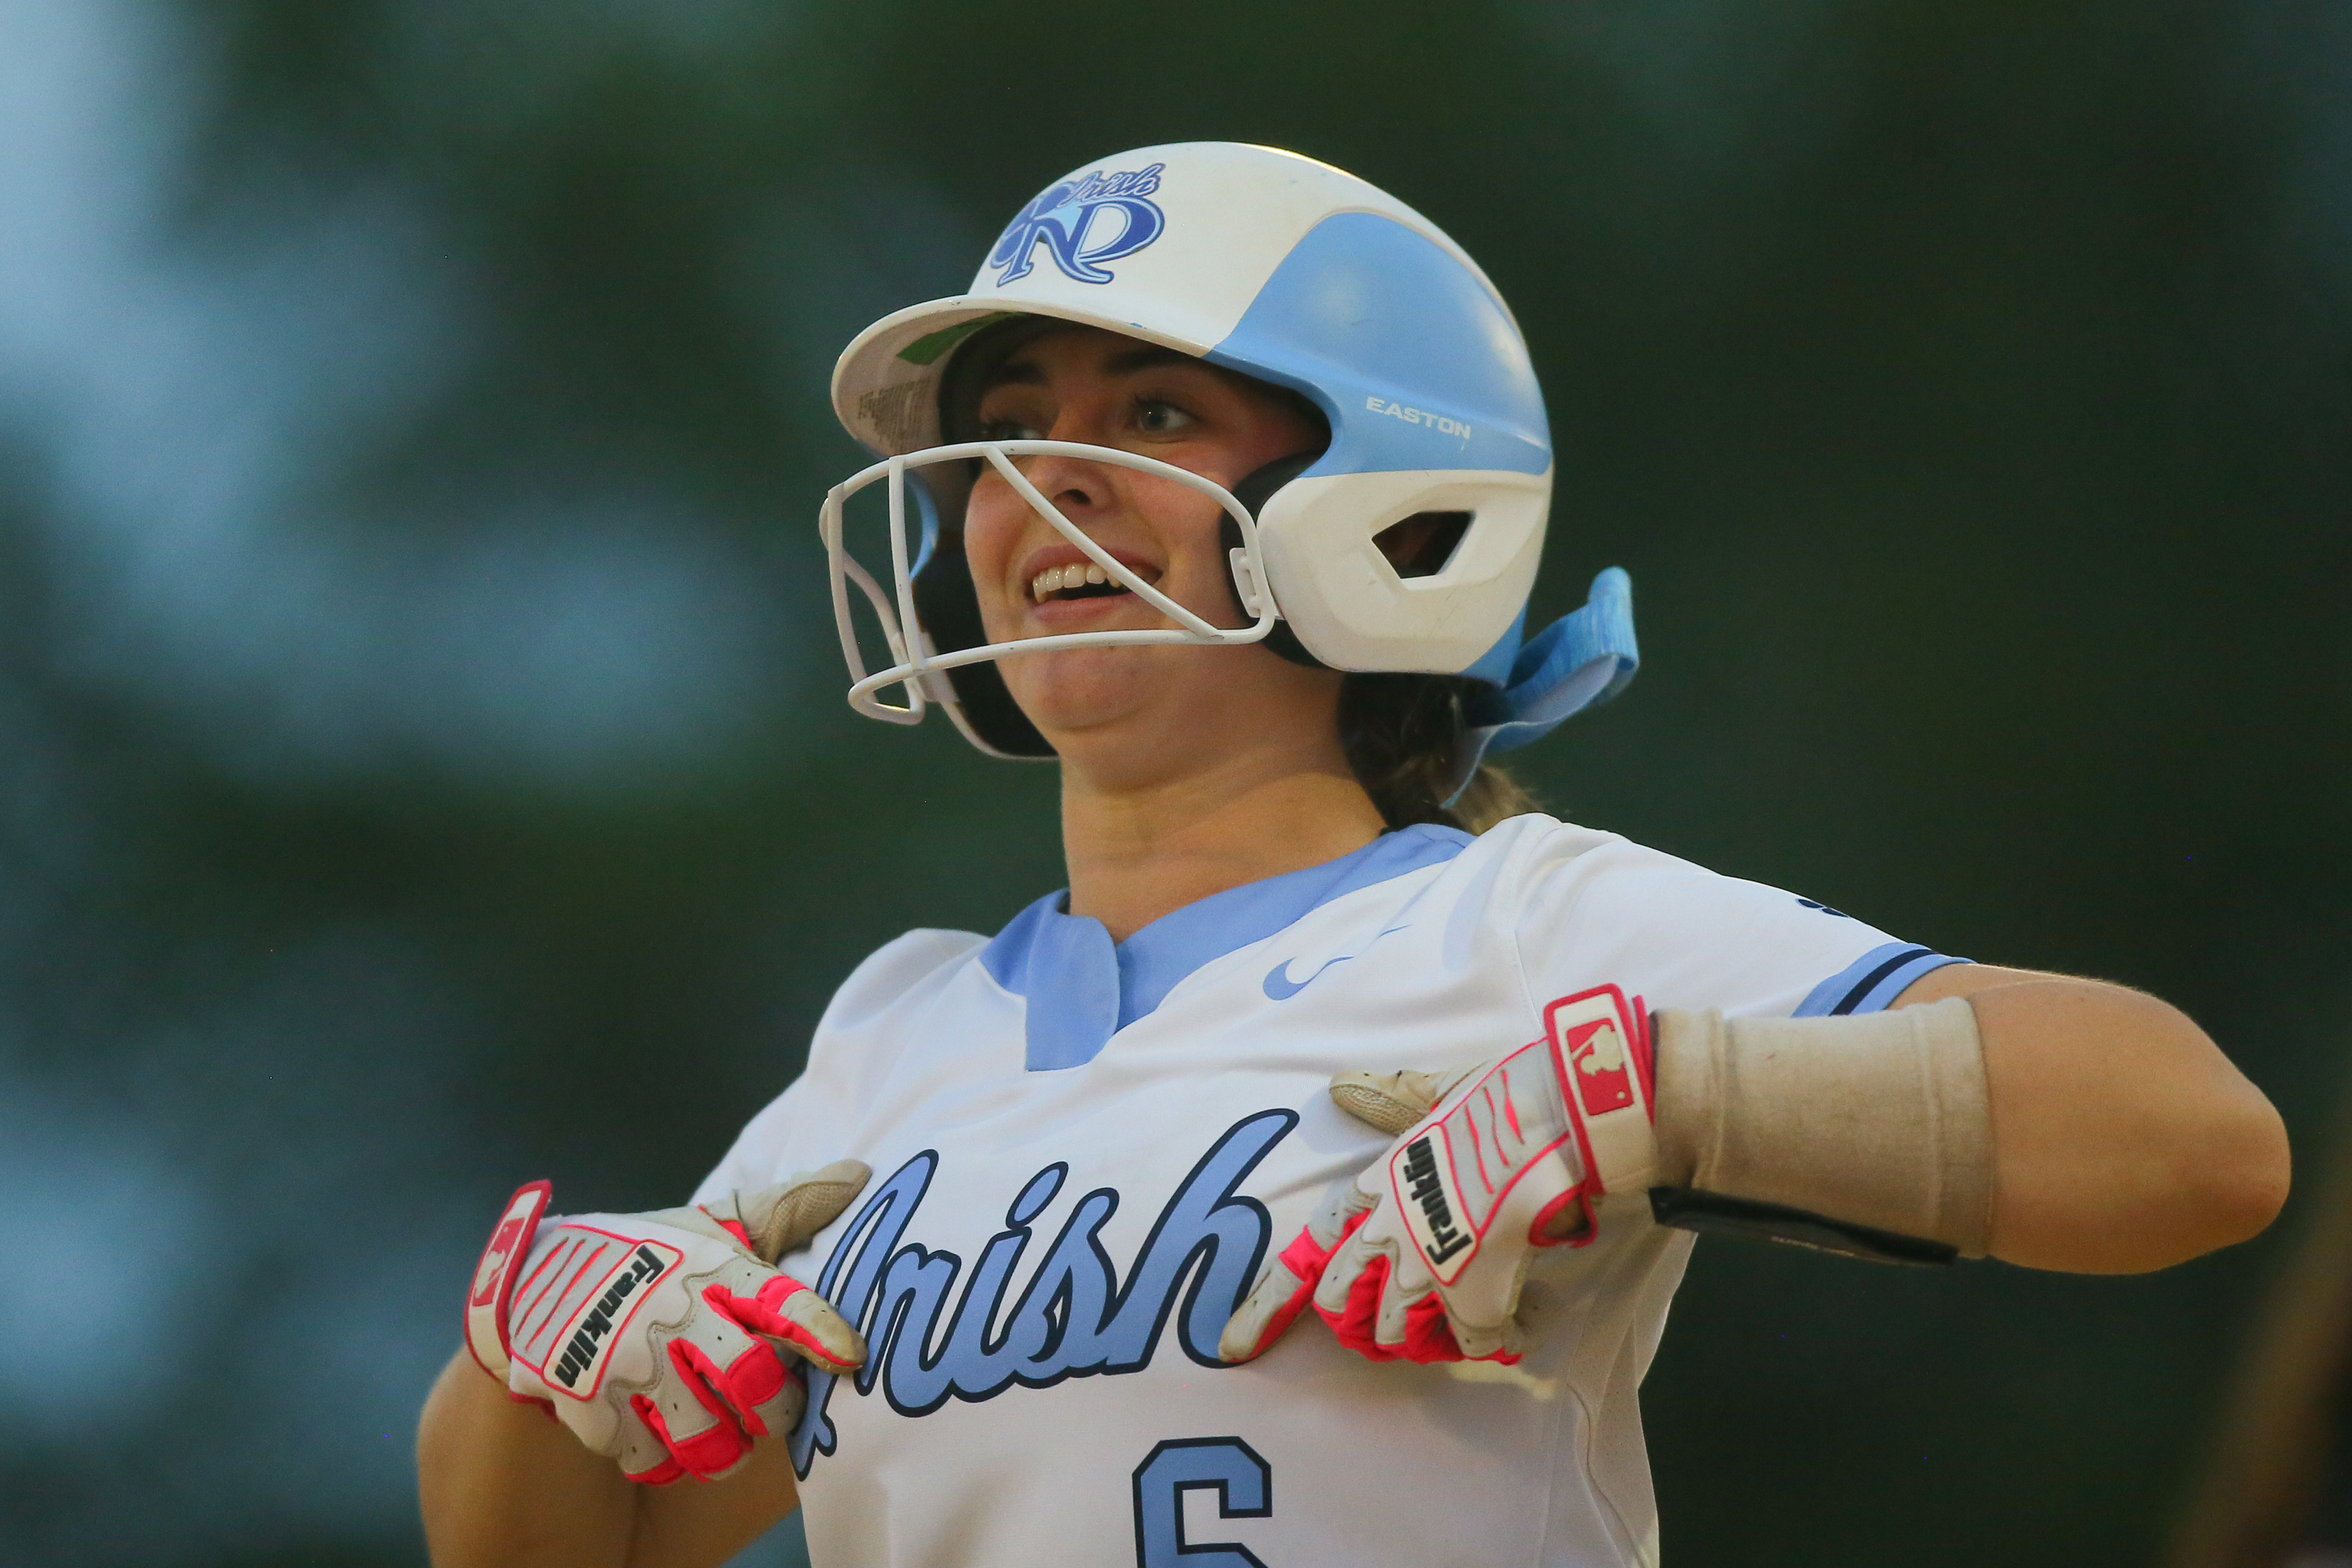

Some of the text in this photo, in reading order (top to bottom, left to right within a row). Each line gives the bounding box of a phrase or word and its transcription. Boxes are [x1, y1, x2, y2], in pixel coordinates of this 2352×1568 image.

[1366, 396, 1471, 439] EASTON
[1402, 1135, 1473, 1265] Franklin
[555, 1244, 666, 1388] Franklin
[785, 1108, 1299, 1481] Irish
